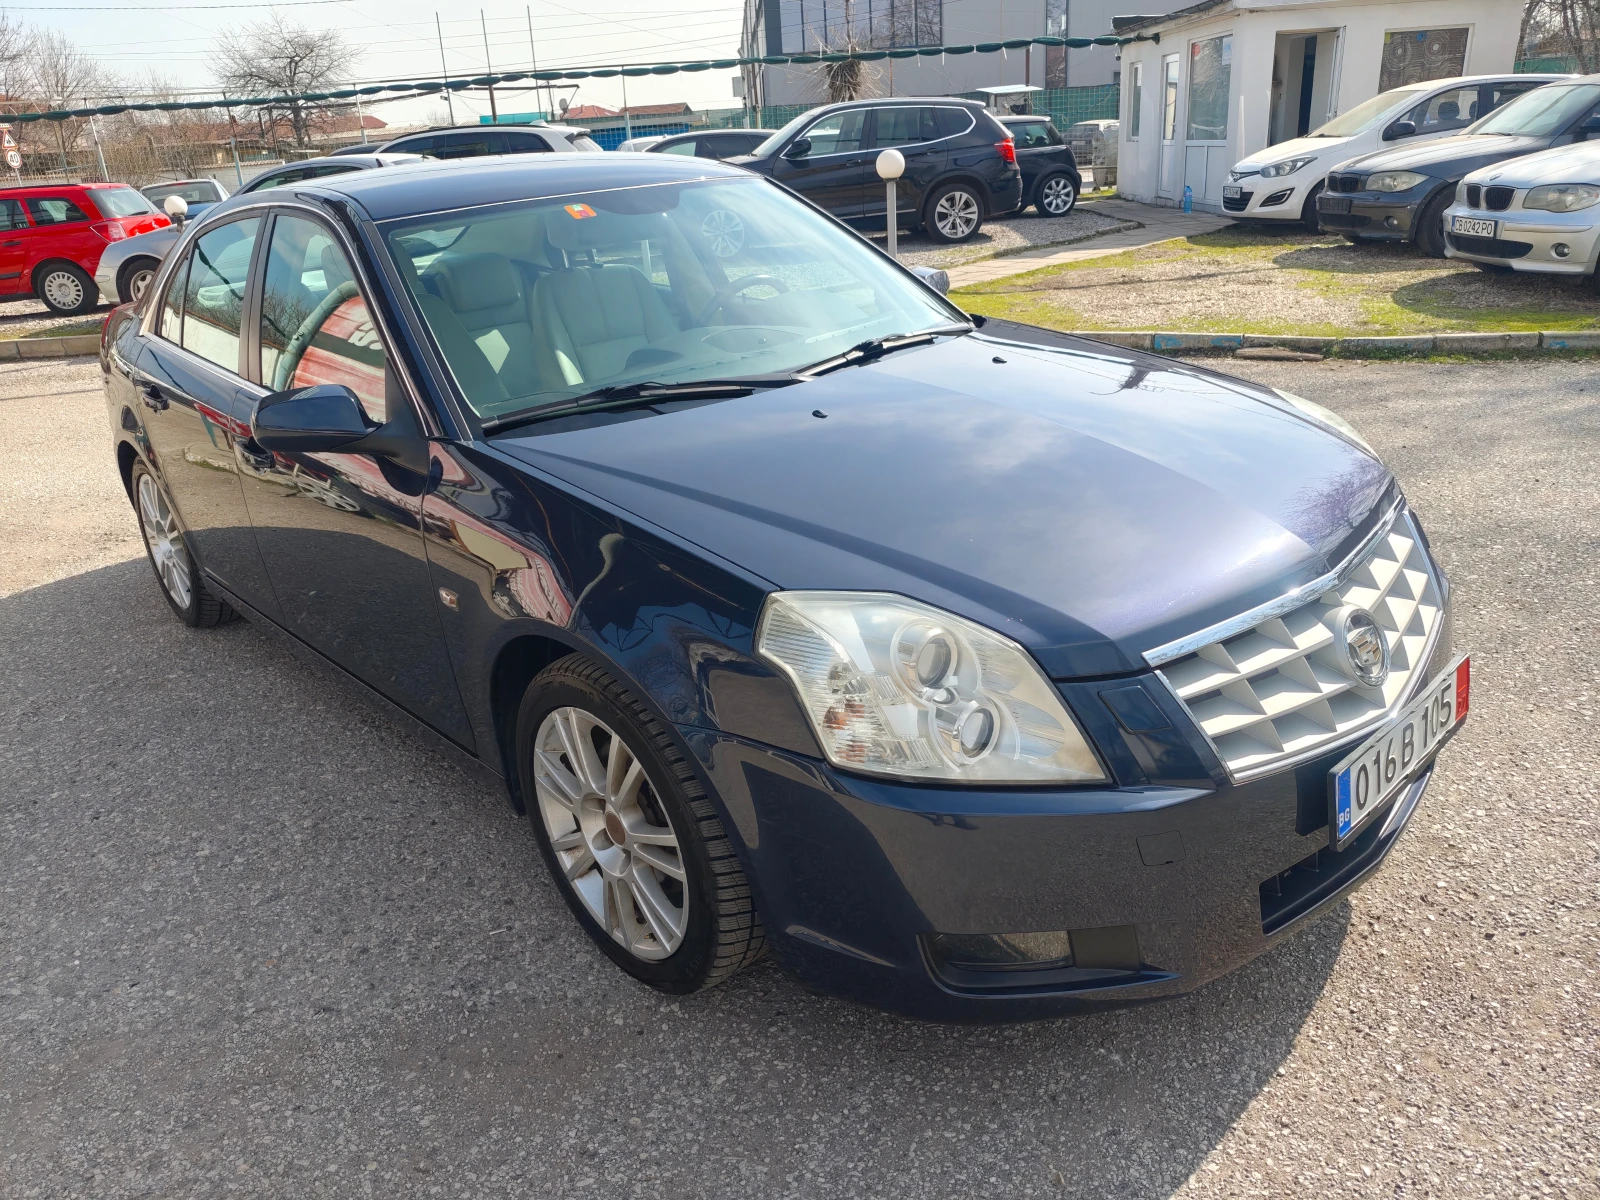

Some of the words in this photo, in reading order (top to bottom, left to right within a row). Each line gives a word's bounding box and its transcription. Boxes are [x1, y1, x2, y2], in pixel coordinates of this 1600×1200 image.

[10, 154, 18, 163] 40
[1464, 220, 1480, 233] 0242
[1355, 737, 1397, 810] 016
[1402, 722, 1414, 770] B
[1421, 681, 1452, 749] 105
[1338, 807, 1350, 828] BG
